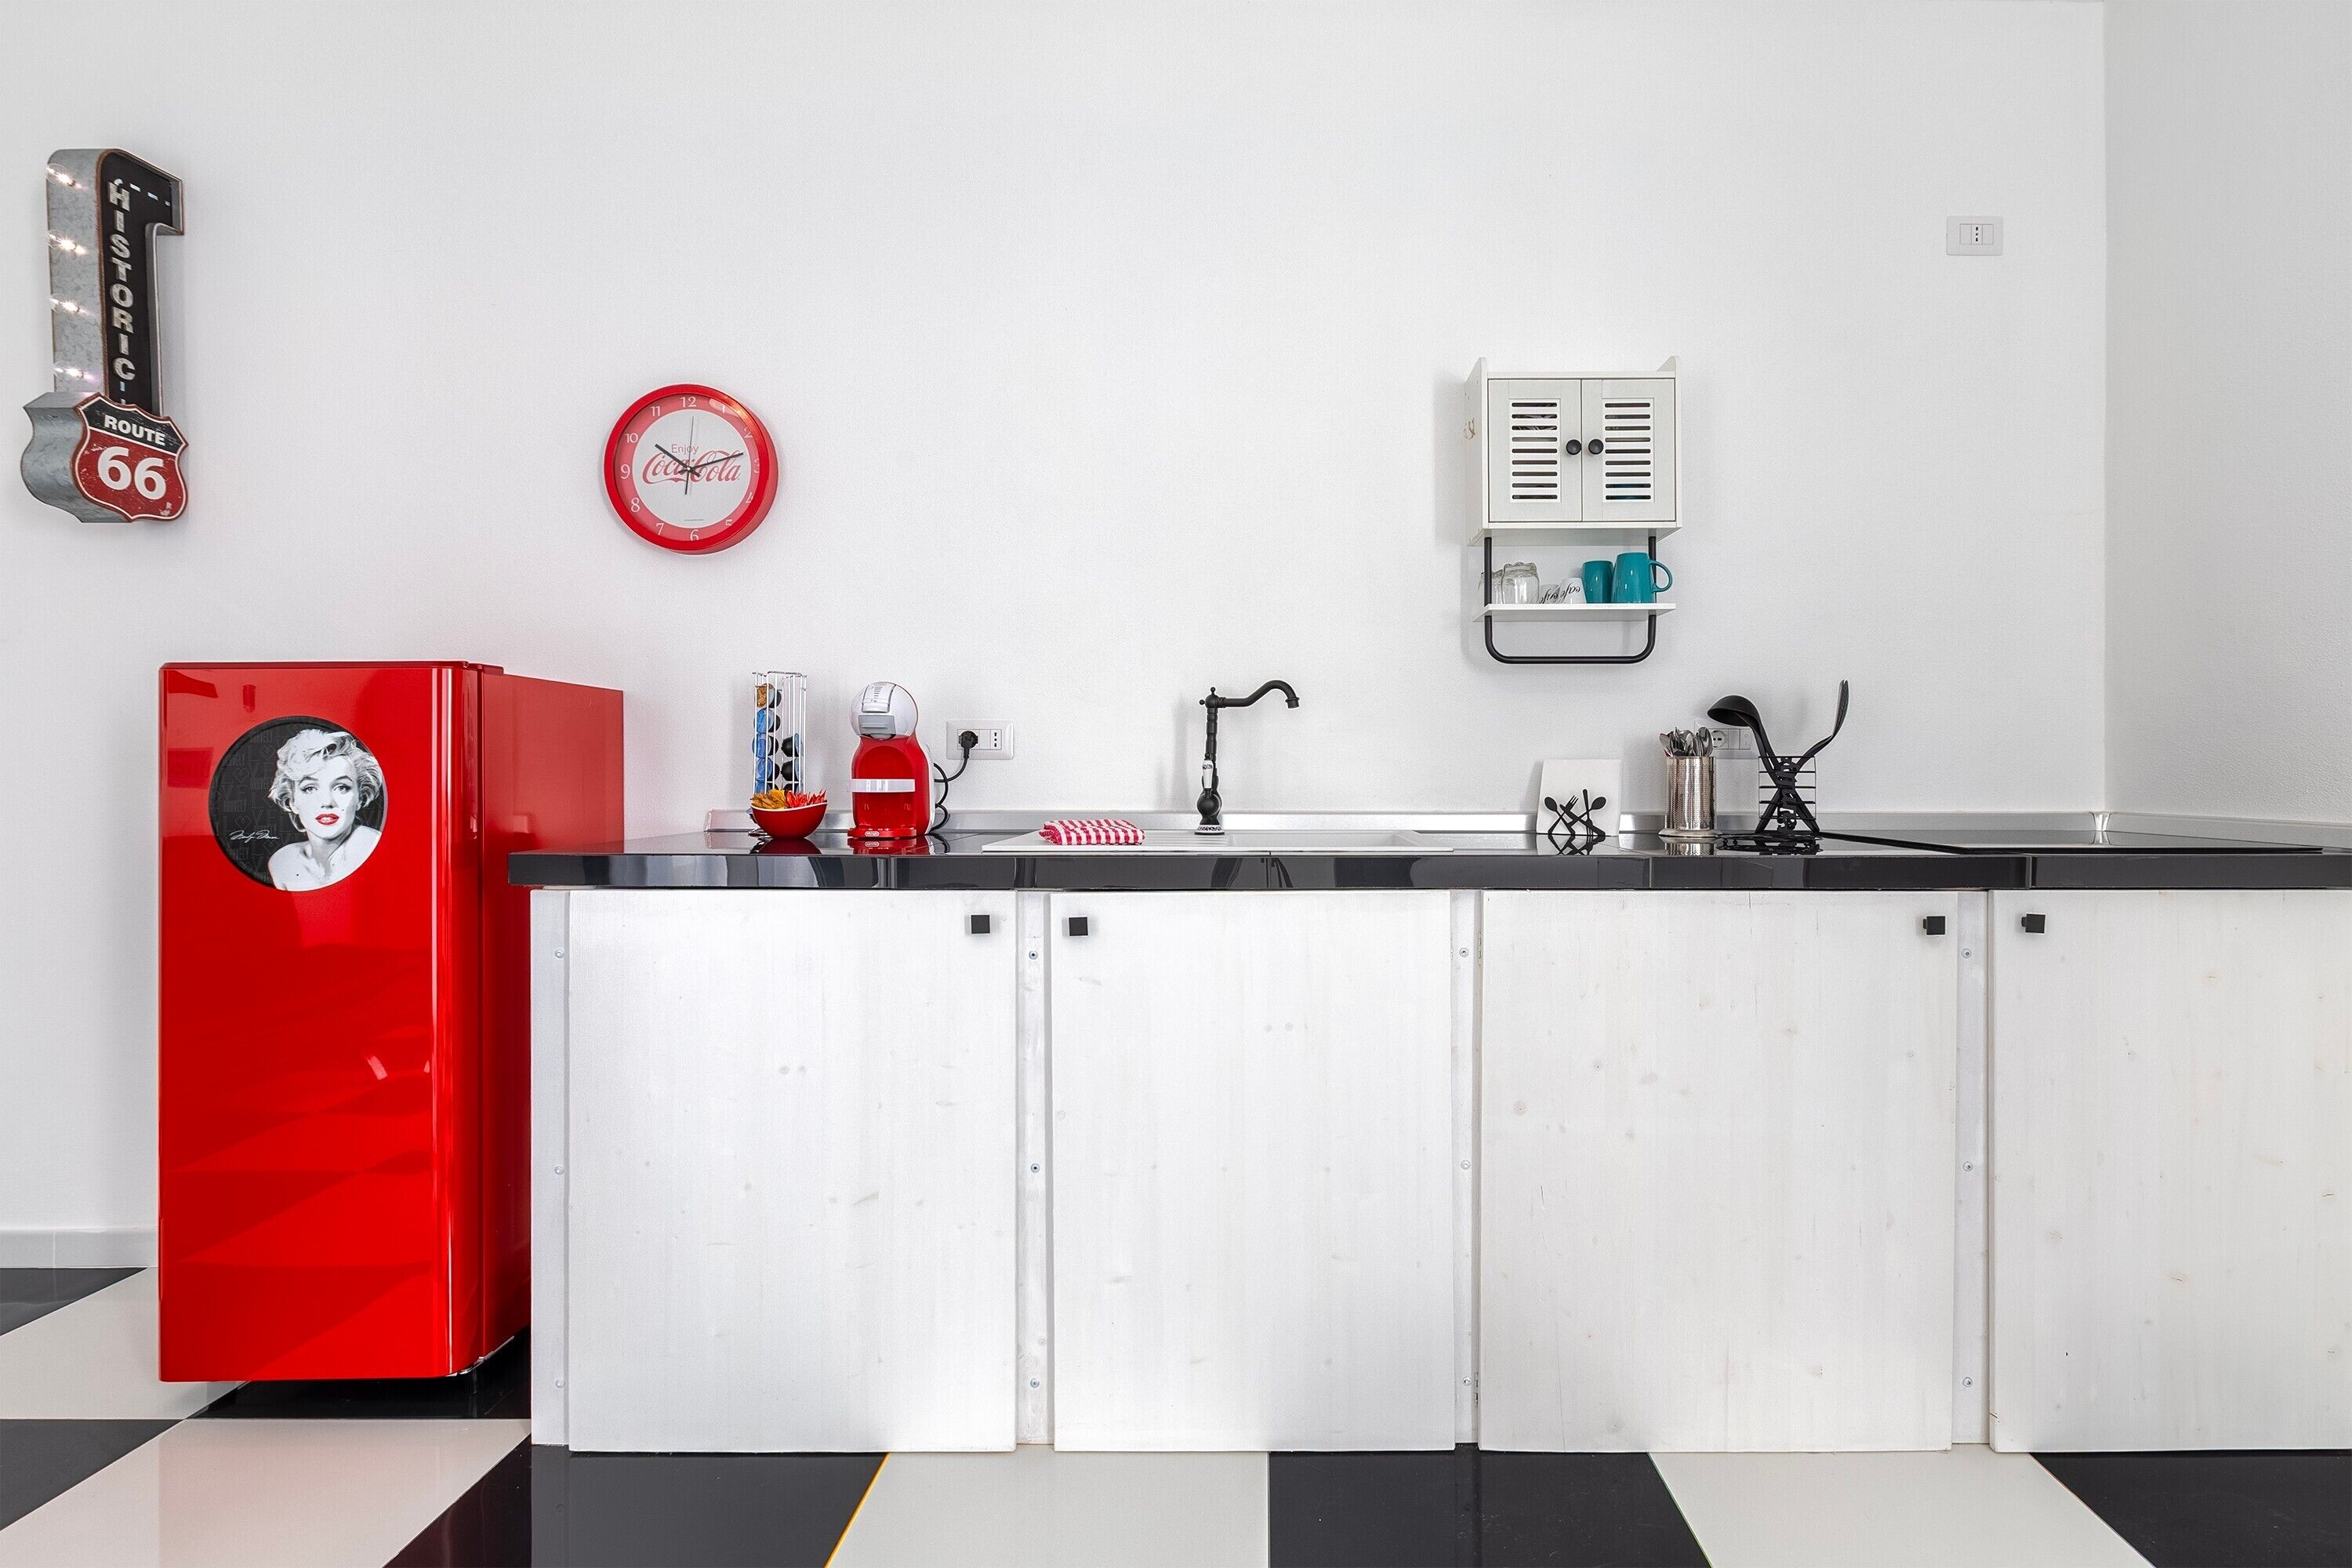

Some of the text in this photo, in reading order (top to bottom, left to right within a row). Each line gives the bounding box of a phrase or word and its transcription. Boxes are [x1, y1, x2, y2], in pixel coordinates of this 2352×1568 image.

[107, 181, 136, 381] HISTORIC
[681, 396, 697, 407] 12
[650, 405, 661, 416] 11
[103, 414, 165, 446] ROUTE
[624, 432, 639, 443] 10
[671, 444, 699, 454] Enjoy
[97, 446, 167, 500] 66
[620, 463, 630, 480] 9
[631, 497, 641, 513] 8
[655, 522, 665, 536] 7
[690, 529, 699, 542] 6
